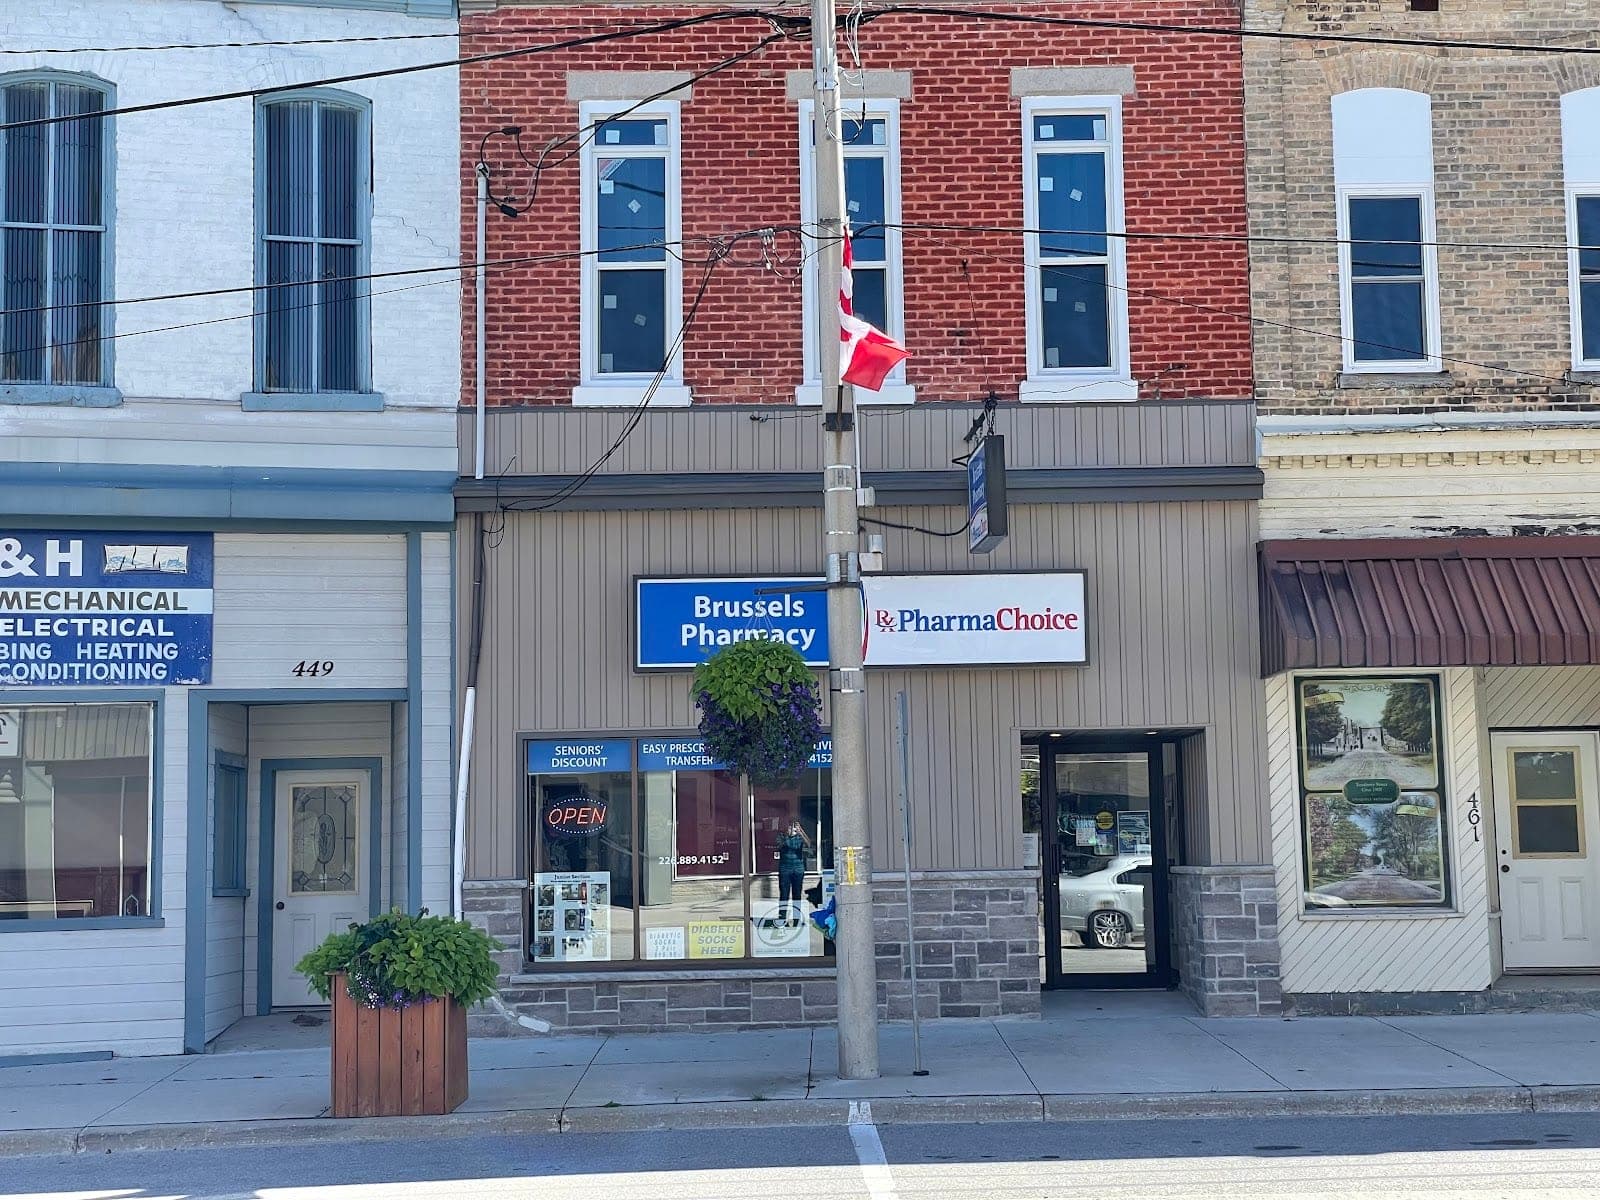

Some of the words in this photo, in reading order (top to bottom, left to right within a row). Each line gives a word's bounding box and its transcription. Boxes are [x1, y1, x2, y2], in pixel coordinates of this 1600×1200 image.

[45, 540, 83, 576] H
[0, 591, 188, 611] MECHANICAL
[694, 594, 805, 617] Brussels
[0, 618, 174, 636] ELECTRICAL
[76, 642, 179, 660] HEATING
[0, 662, 168, 680] CONDITIONING
[292, 660, 334, 677] 449
[643, 743, 667, 754] EASY
[551, 757, 608, 768] DISCOUNT
[549, 806, 607, 826] OPEN
[1467, 791, 1480, 842] 461
[658, 855, 724, 865] 226.889.4152
[691, 925, 743, 934] DIABETIC
[697, 935, 736, 945] SOCKS
[701, 946, 734, 955] HERE
